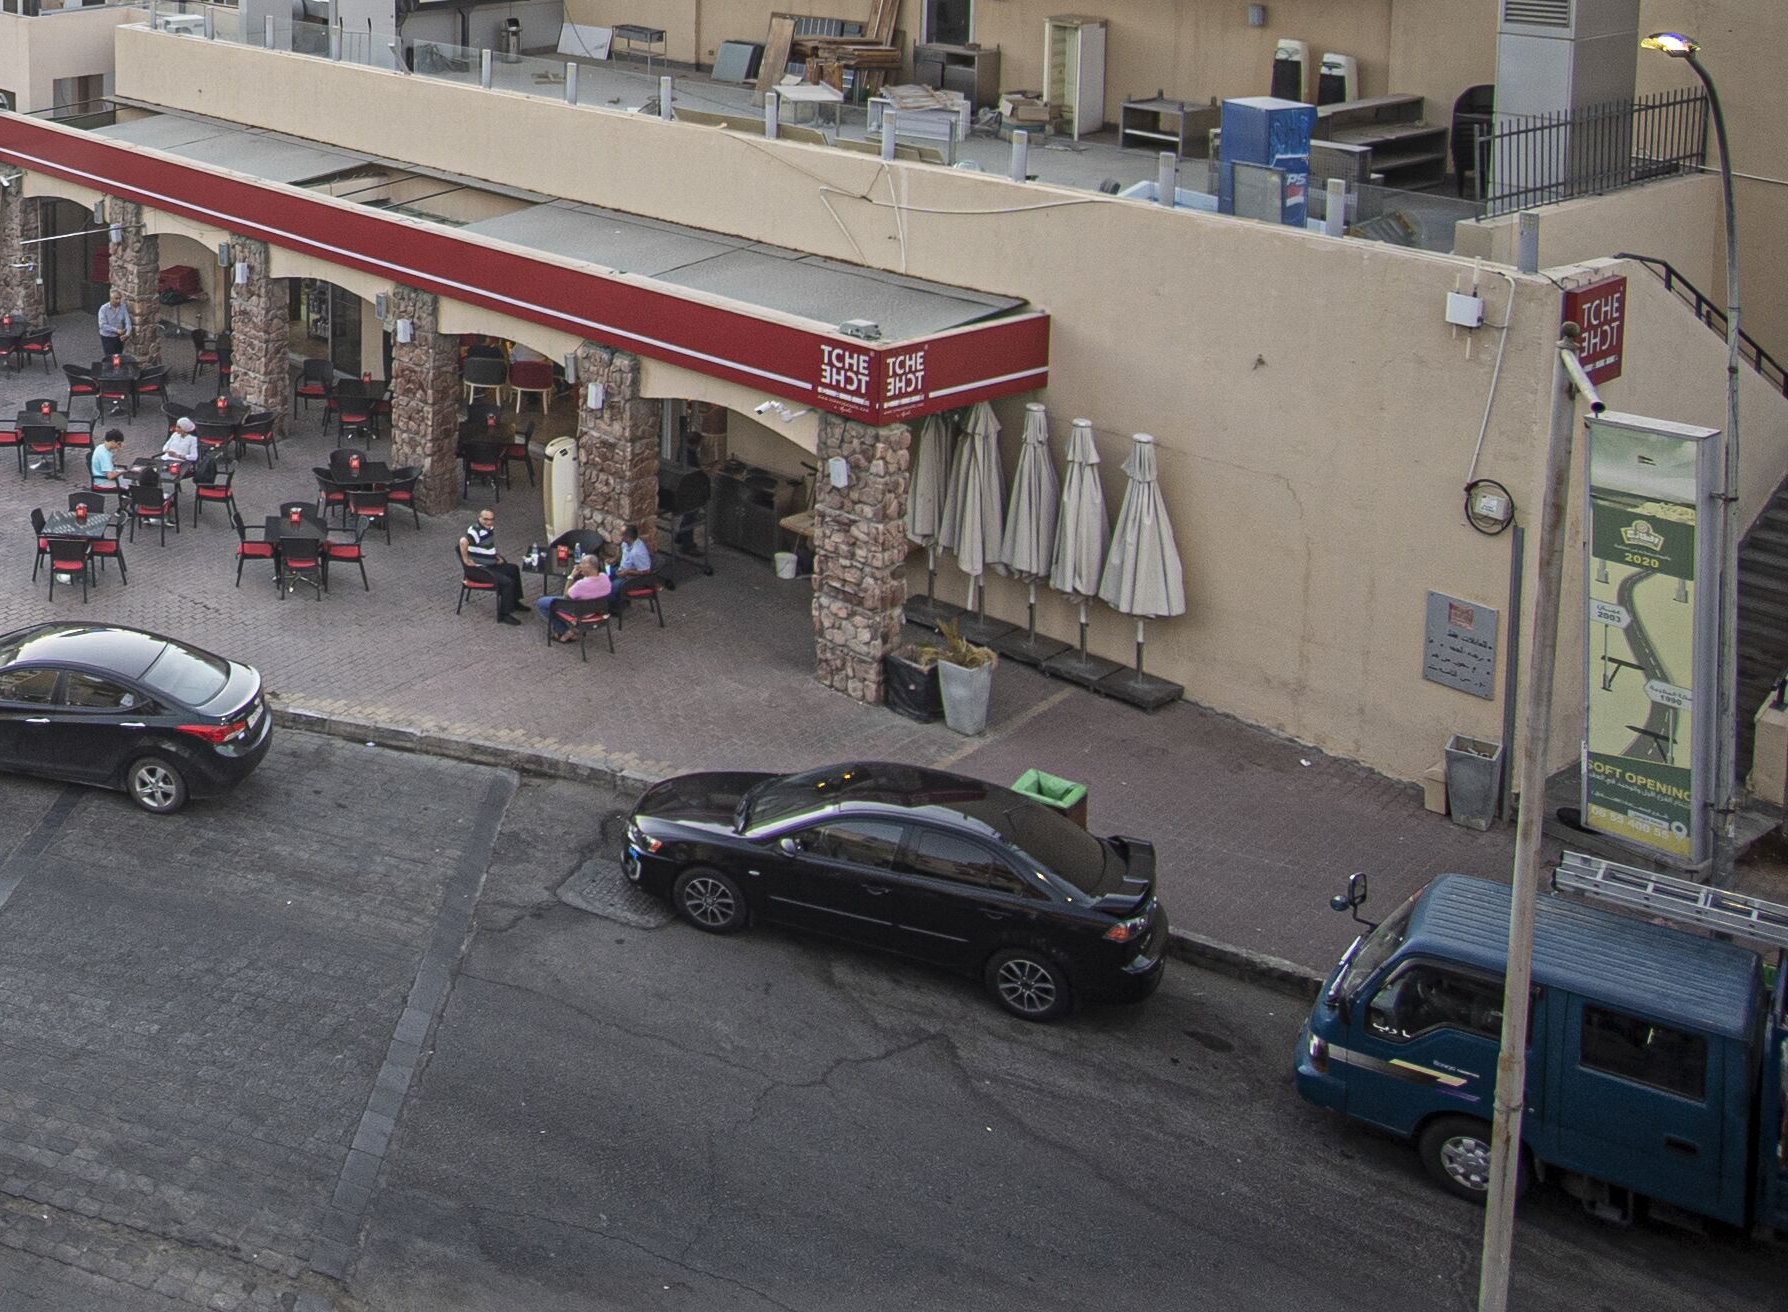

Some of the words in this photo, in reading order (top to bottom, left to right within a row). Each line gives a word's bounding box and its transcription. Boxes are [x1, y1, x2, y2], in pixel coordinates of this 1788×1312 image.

[1582, 292, 1621, 328] TCHE
[820, 344, 870, 375] TCHE
[886, 351, 925, 377] TCHE
[1624, 552, 1660, 568] 2020
